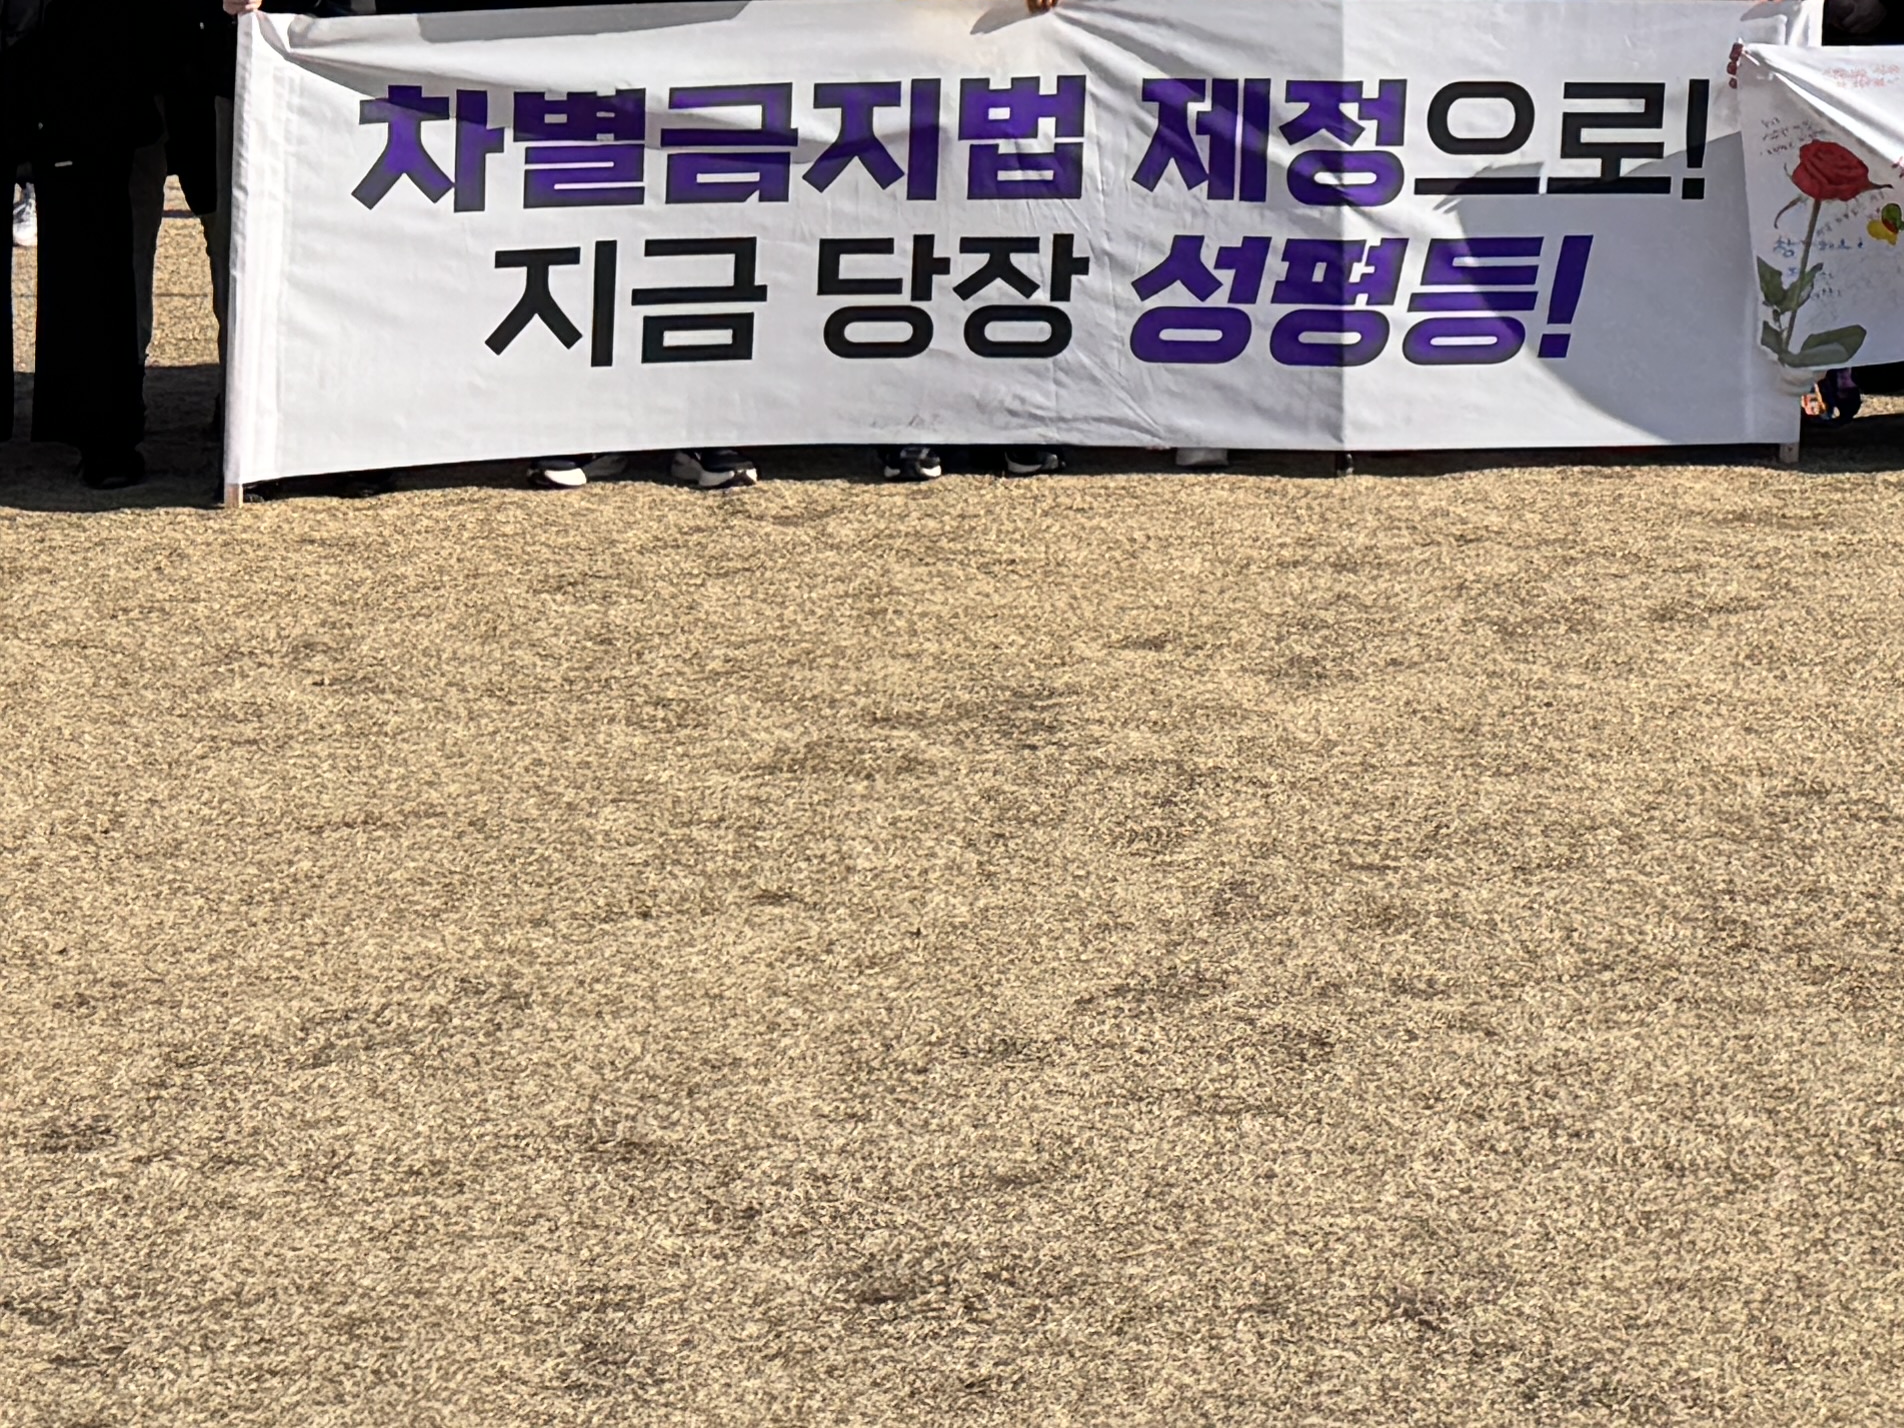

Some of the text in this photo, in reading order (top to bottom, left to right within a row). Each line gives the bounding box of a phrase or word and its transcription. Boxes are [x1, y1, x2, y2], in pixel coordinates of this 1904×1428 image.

[350, 74, 1708, 214] 차별금지법 제정으로!
[484, 233, 1592, 369] 지금 당장 성평등!
